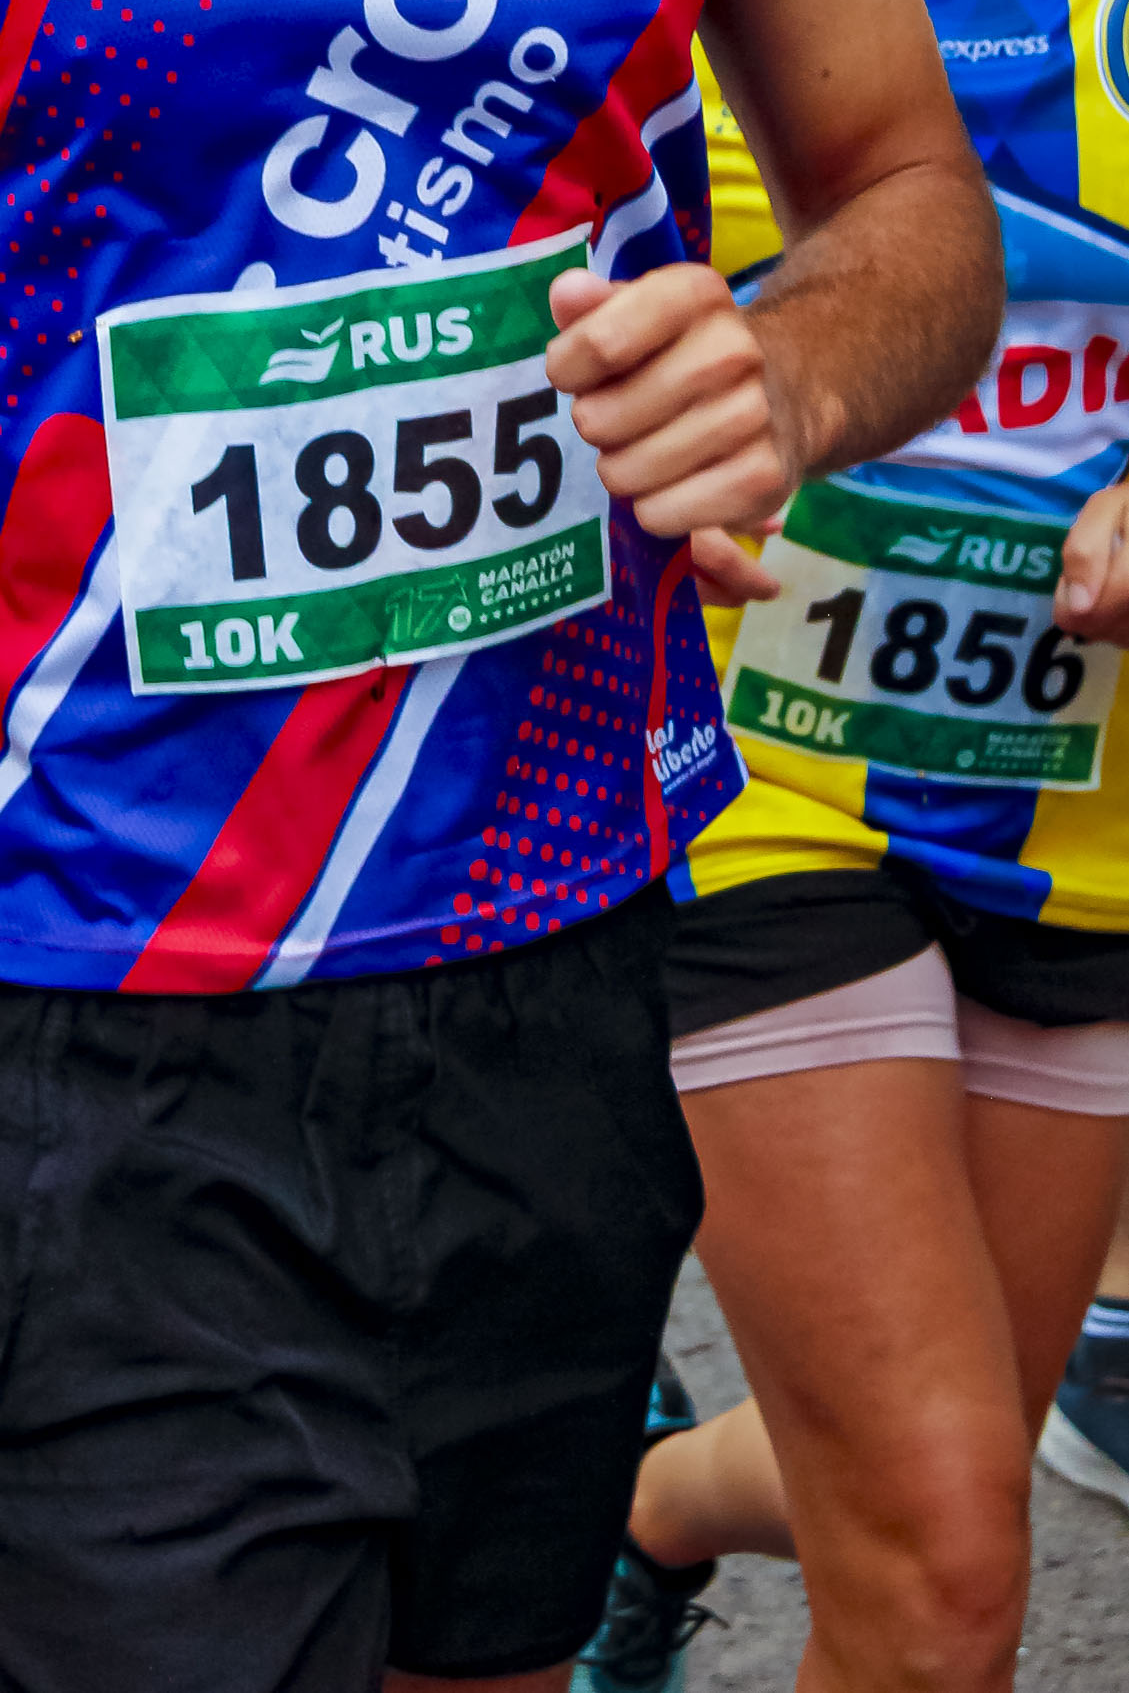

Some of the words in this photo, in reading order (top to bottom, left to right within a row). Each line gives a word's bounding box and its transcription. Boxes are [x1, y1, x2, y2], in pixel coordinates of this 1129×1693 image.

[938, 35, 1049, 62] express
[350, 307, 474, 370] RUS
[190, 387, 563, 582] 1855
[480, 561, 573, 606] CANALLA
[958, 535, 1055, 580] RUS
[180, 612, 305, 671] 10K
[806, 587, 1087, 714] 1856
[757, 689, 851, 747] 10K
